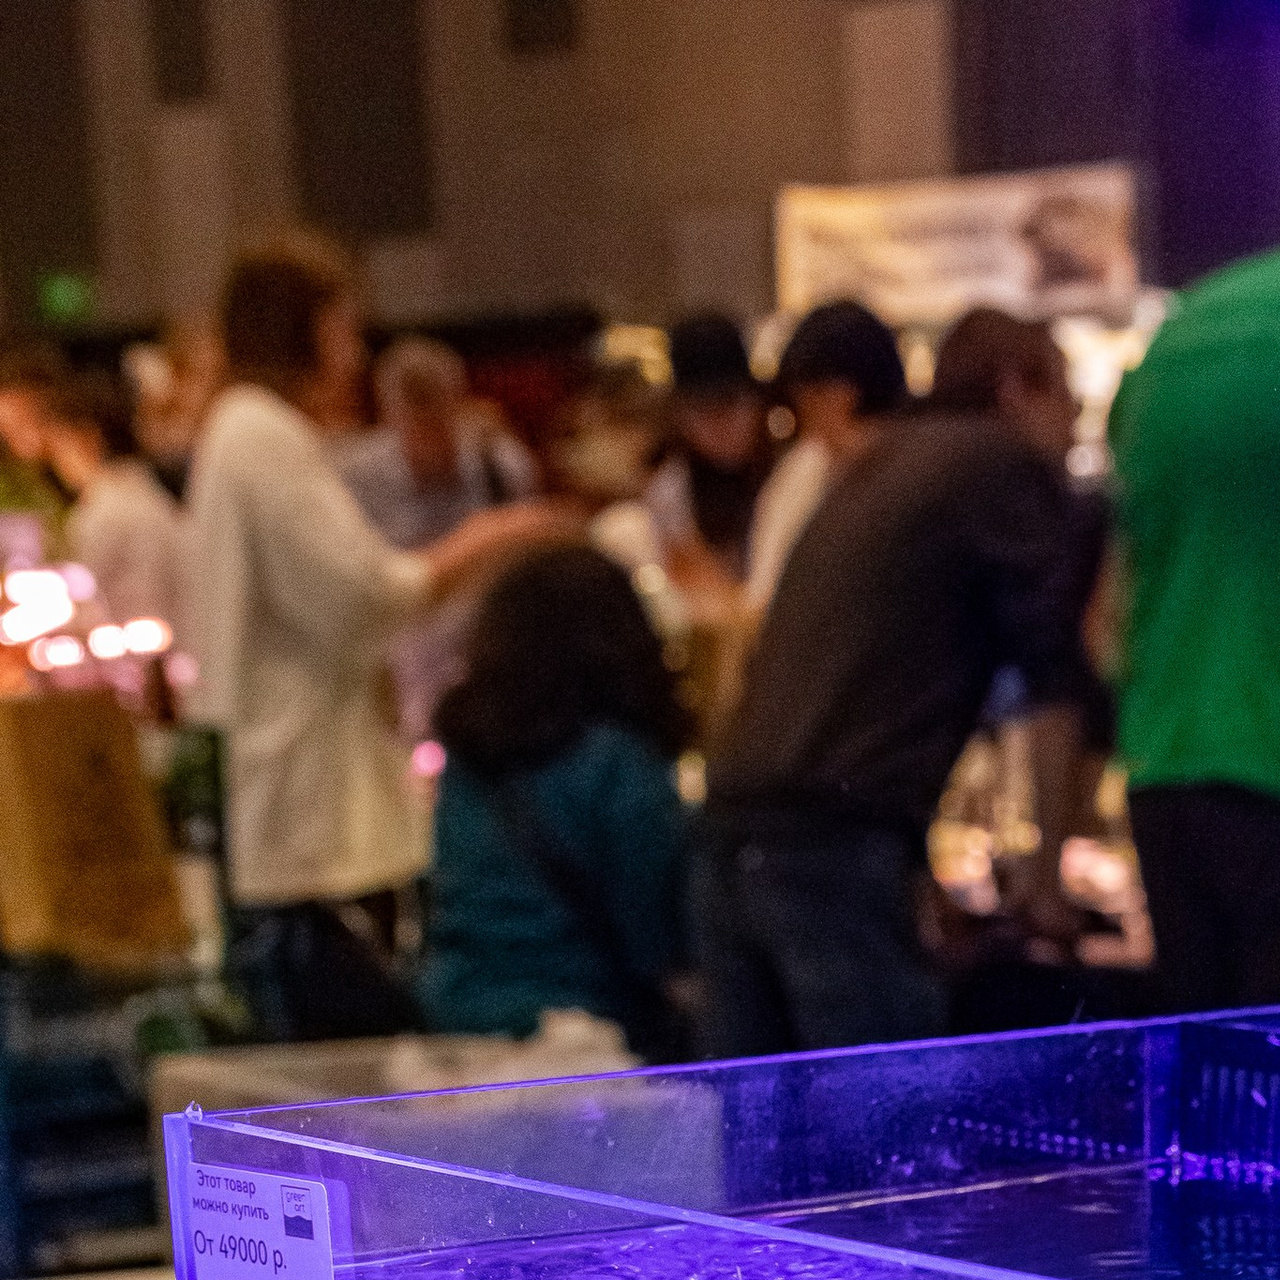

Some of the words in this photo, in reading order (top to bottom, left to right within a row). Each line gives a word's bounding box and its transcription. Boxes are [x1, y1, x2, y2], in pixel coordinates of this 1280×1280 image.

[196, 1169, 221, 1189] Этот
[224, 1178, 256, 1199] товар
[192, 1197, 229, 1213] можно
[231, 1205, 269, 1221] купить
[194, 1230, 213, 1256] От
[219, 1234, 268, 1266] 49000
